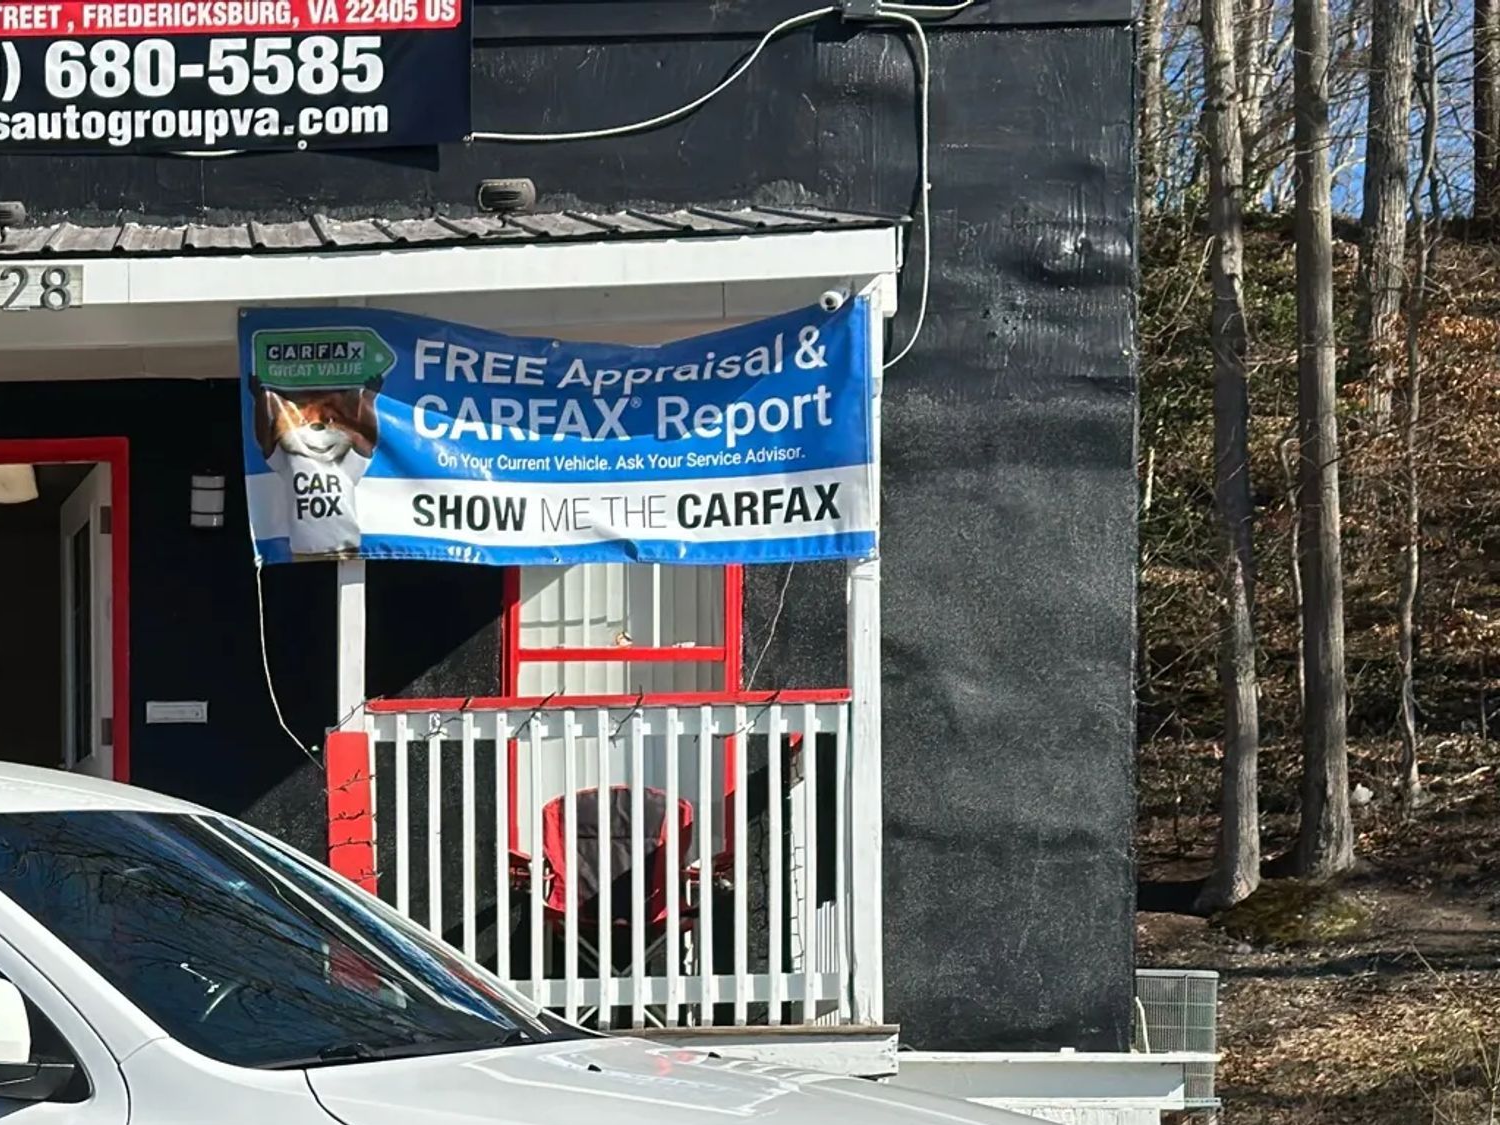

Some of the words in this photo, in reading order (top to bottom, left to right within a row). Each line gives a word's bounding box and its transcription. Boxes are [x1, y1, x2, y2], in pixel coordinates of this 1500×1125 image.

[83, 0, 299, 28] FREDERICKSBURG,
[307, 0, 339, 24] VA
[345, 0, 417, 23] 22405
[425, 0, 455, 21] US
[45, 36, 383, 99] 680-5585
[267, 342, 365, 361] CARFAX
[414, 338, 547, 386] FREE
[556, 332, 783, 395] Appraisal
[794, 325, 828, 370] &
[268, 364, 313, 377] GREAT
[318, 362, 362, 377] VALUE
[657, 384, 833, 448] Report
[438, 451, 457, 467] On
[462, 453, 493, 471] Your
[497, 454, 550, 471] Current
[554, 455, 612, 471] Vehicle.
[615, 455, 644, 471] Ask
[648, 454, 682, 469] Your
[686, 451, 741, 467] Service
[745, 446, 806, 464] Advisor.
[293, 471, 342, 495] CAR
[296, 496, 343, 520] FOX
[412, 493, 527, 532] SHOW
[541, 497, 592, 532] ME
[602, 495, 667, 529] THE
[677, 483, 841, 529] CARFAX
